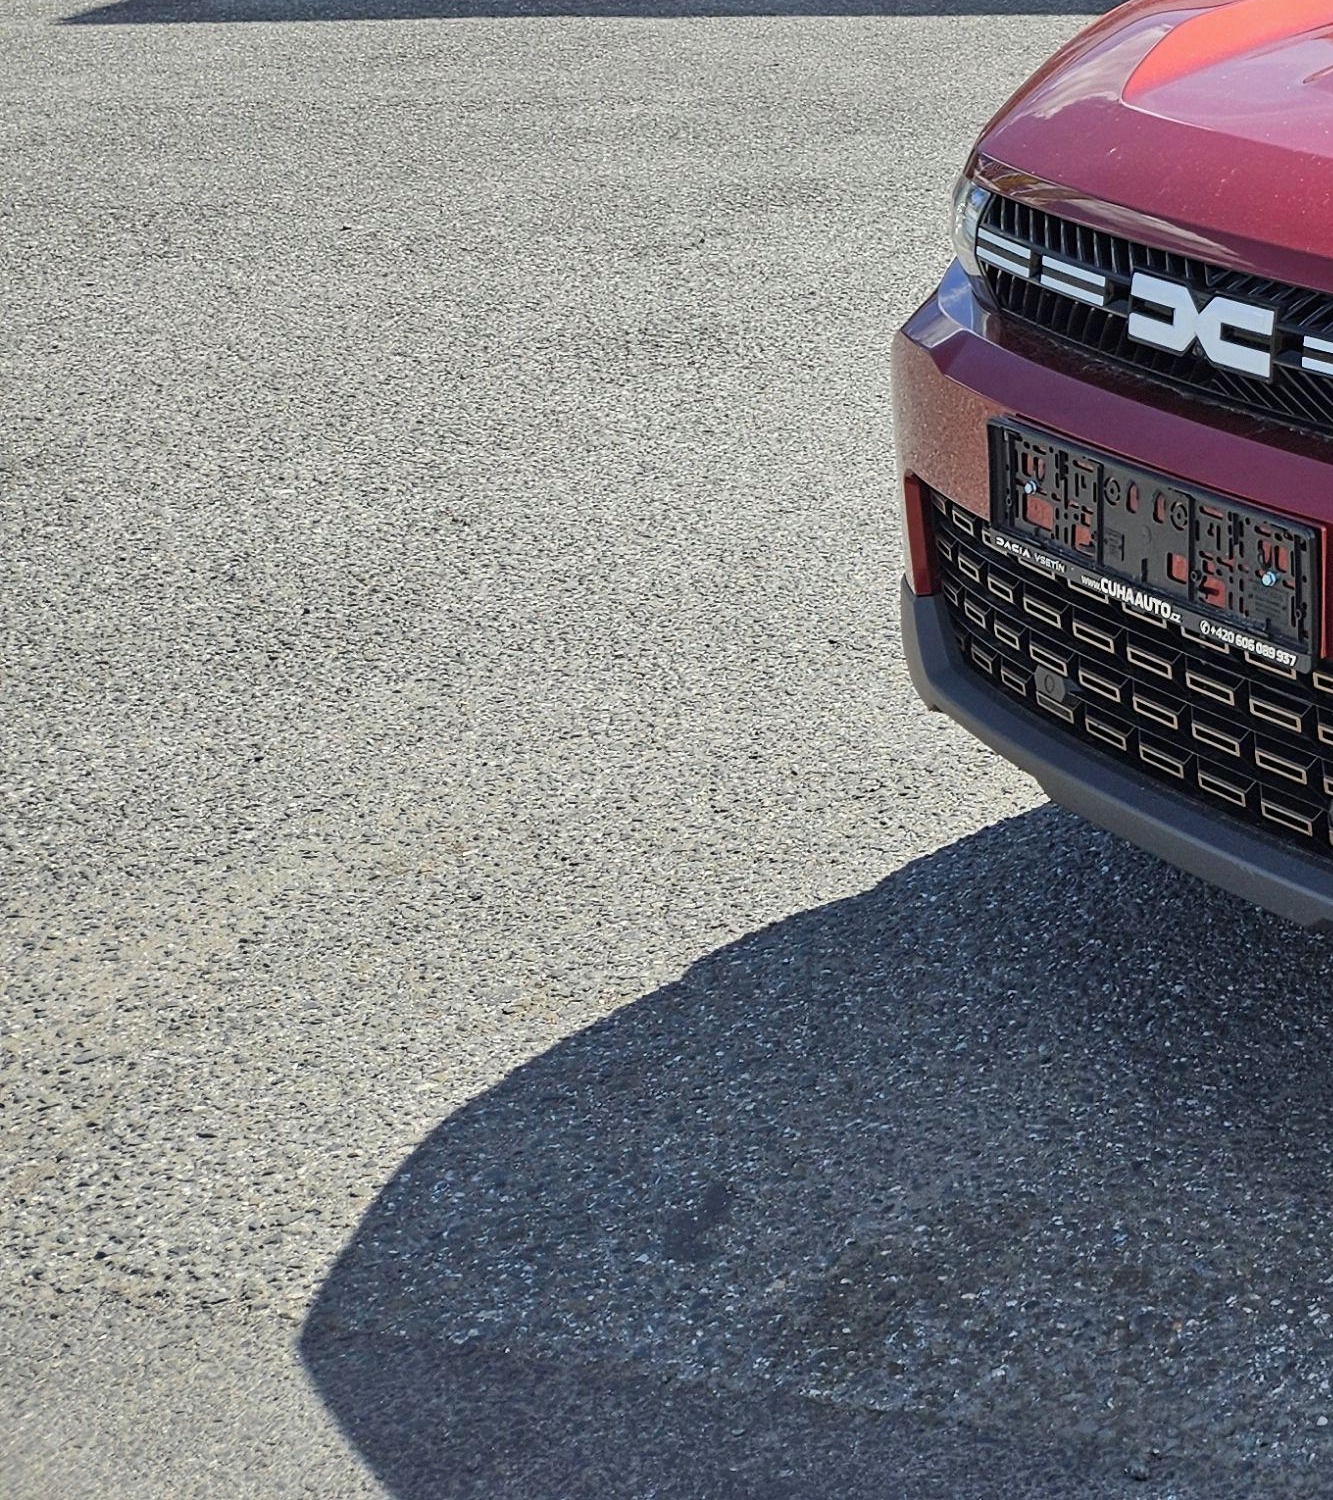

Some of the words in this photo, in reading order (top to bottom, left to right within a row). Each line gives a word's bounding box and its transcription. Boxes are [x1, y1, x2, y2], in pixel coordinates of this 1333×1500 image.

[995, 537, 1031, 559] DACIA
[1033, 552, 1066, 573] VSETÍN
[1235, 634, 1255, 651] 606
[1276, 649, 1297, 667] 937
